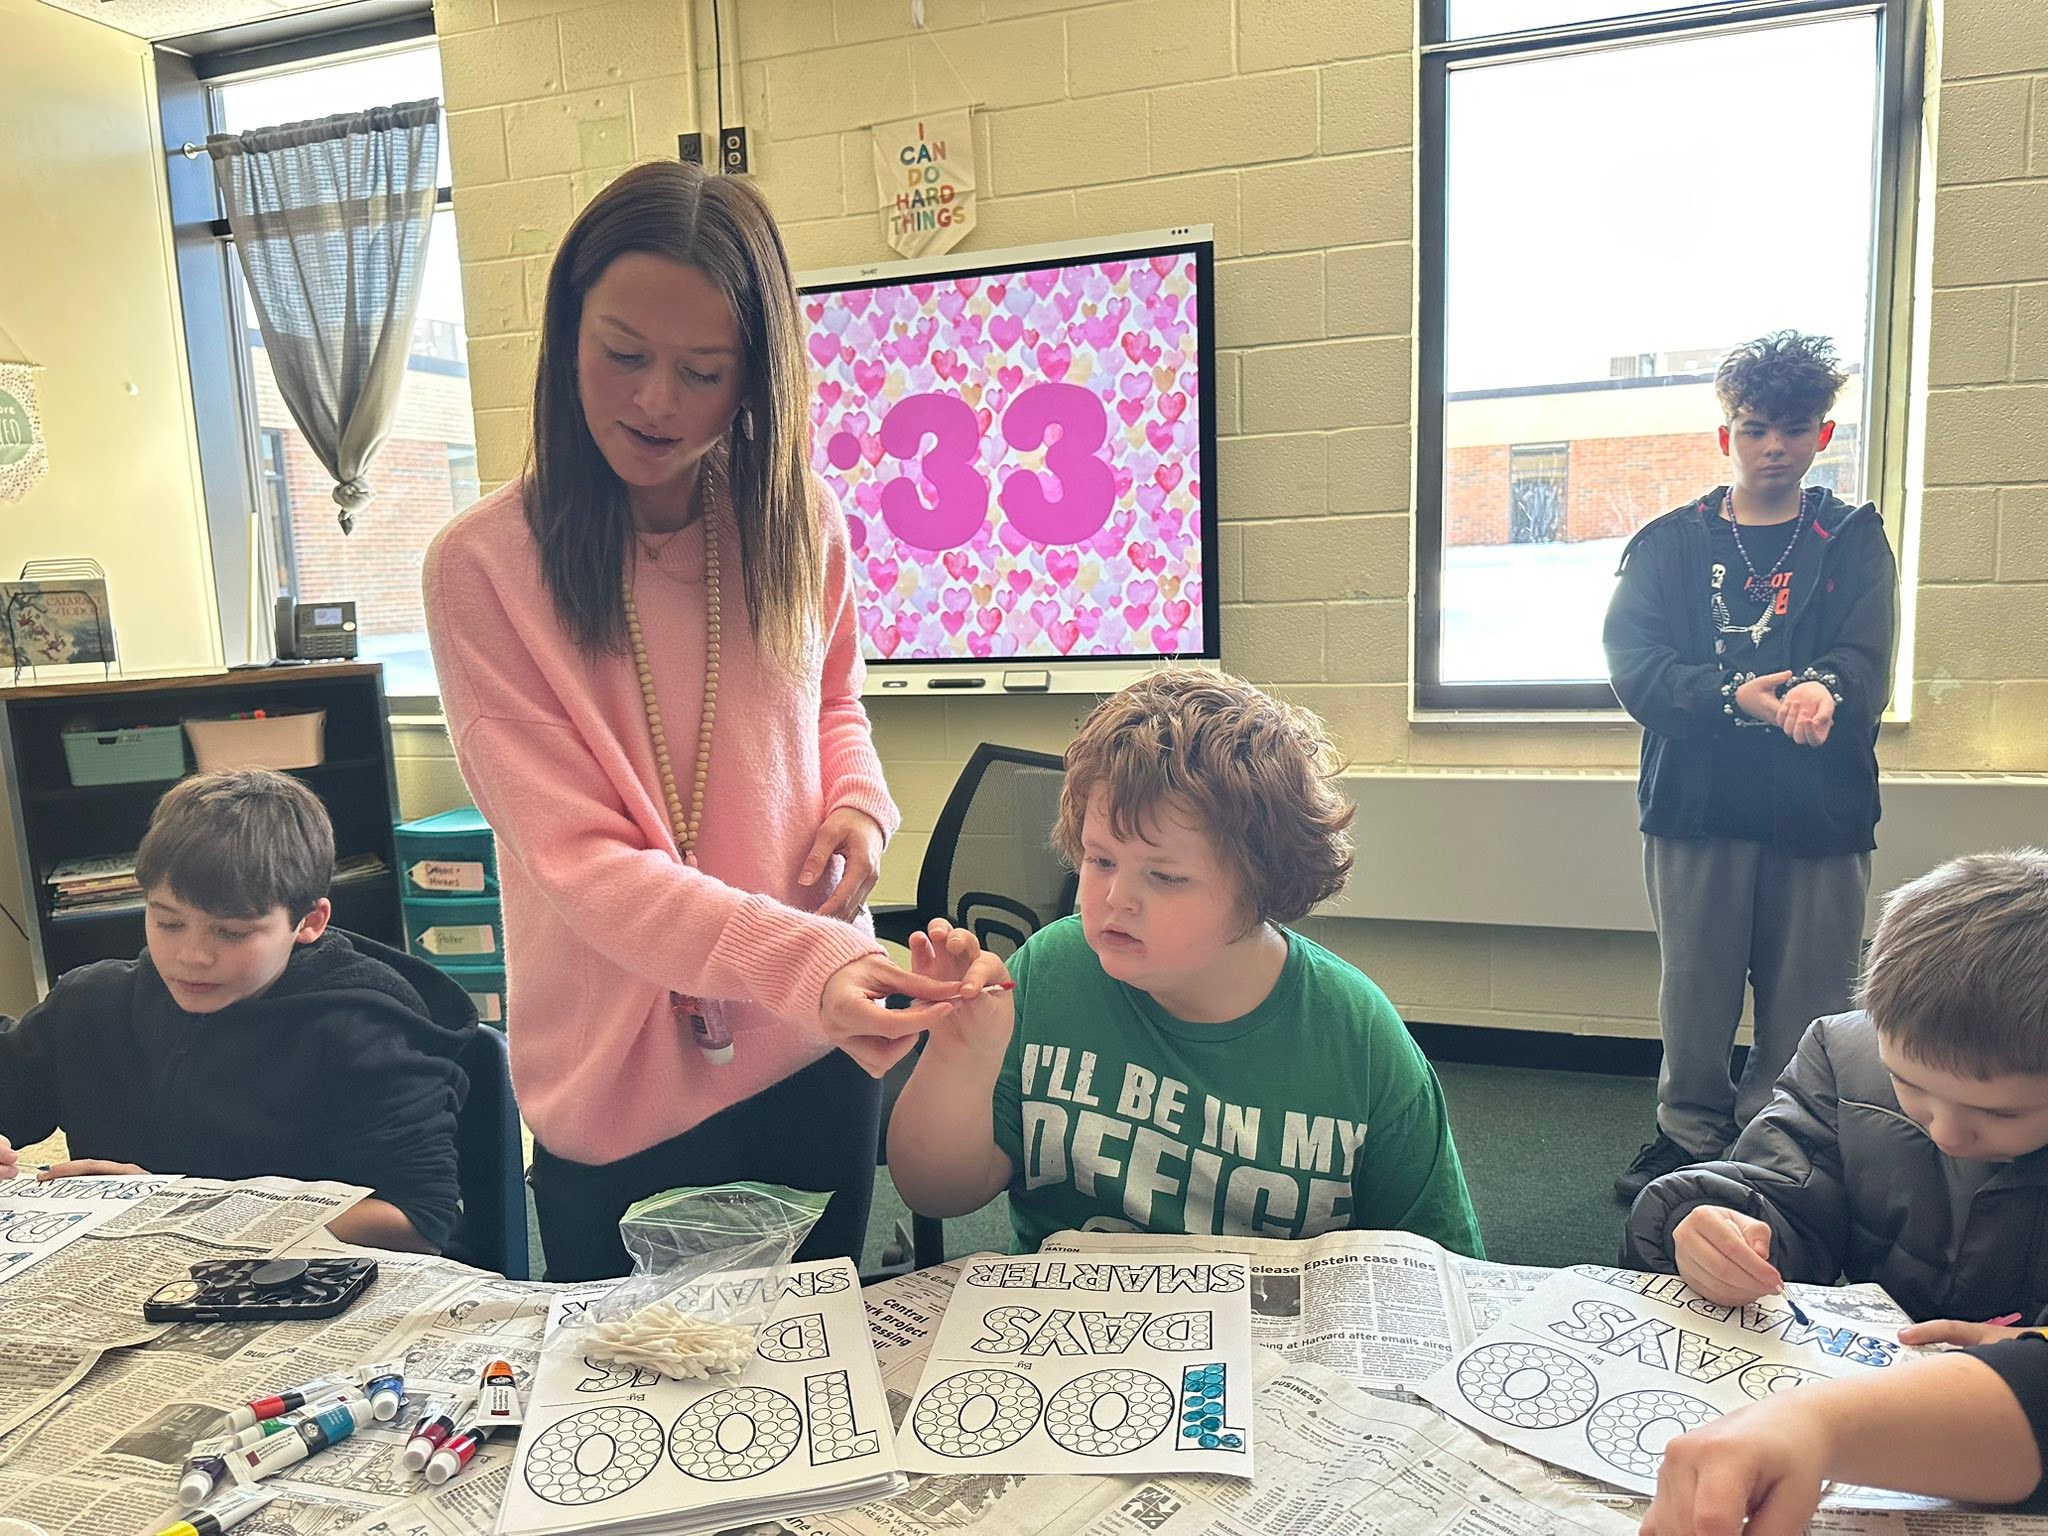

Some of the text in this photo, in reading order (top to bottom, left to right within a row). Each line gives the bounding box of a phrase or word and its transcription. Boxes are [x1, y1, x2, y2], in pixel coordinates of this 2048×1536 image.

[918, 123, 924, 140] I
[900, 141, 946, 165] CAN
[908, 166, 940, 187] DO
[896, 185, 955, 211] HARD
[891, 206, 965, 235] THINGS
[1021, 1043, 1368, 1176] I'LL BE IN MY
[1021, 1101, 1353, 1239] OFFICE
[293, 1193, 342, 1208] situation
[1304, 1254, 1359, 1271] Epstein
[1364, 1255, 1398, 1266] case
[1402, 1257, 1437, 1273] files
[966, 1263, 1246, 1294] SMARTER
[883, 1299, 931, 1324] Central
[868, 1320, 912, 1347] ressing
[880, 1314, 929, 1338] project
[970, 1306, 1213, 1355] DAYS
[1286, 1341, 1298, 1350] at
[1302, 1332, 1345, 1347] Harvard
[1349, 1331, 1377, 1342] after
[1381, 1334, 1419, 1346] emails
[1423, 1339, 1452, 1353] aired
[1014, 1360, 1032, 1370] By:
[626, 1393, 646, 1402] By:
[1272, 1380, 1323, 1405] BUSINESS
[913, 1362, 1246, 1457] 100
[1457, 1342, 1725, 1479] 00
[524, 1370, 880, 1506] 100
[1111, 1510, 1121, 1518] The
